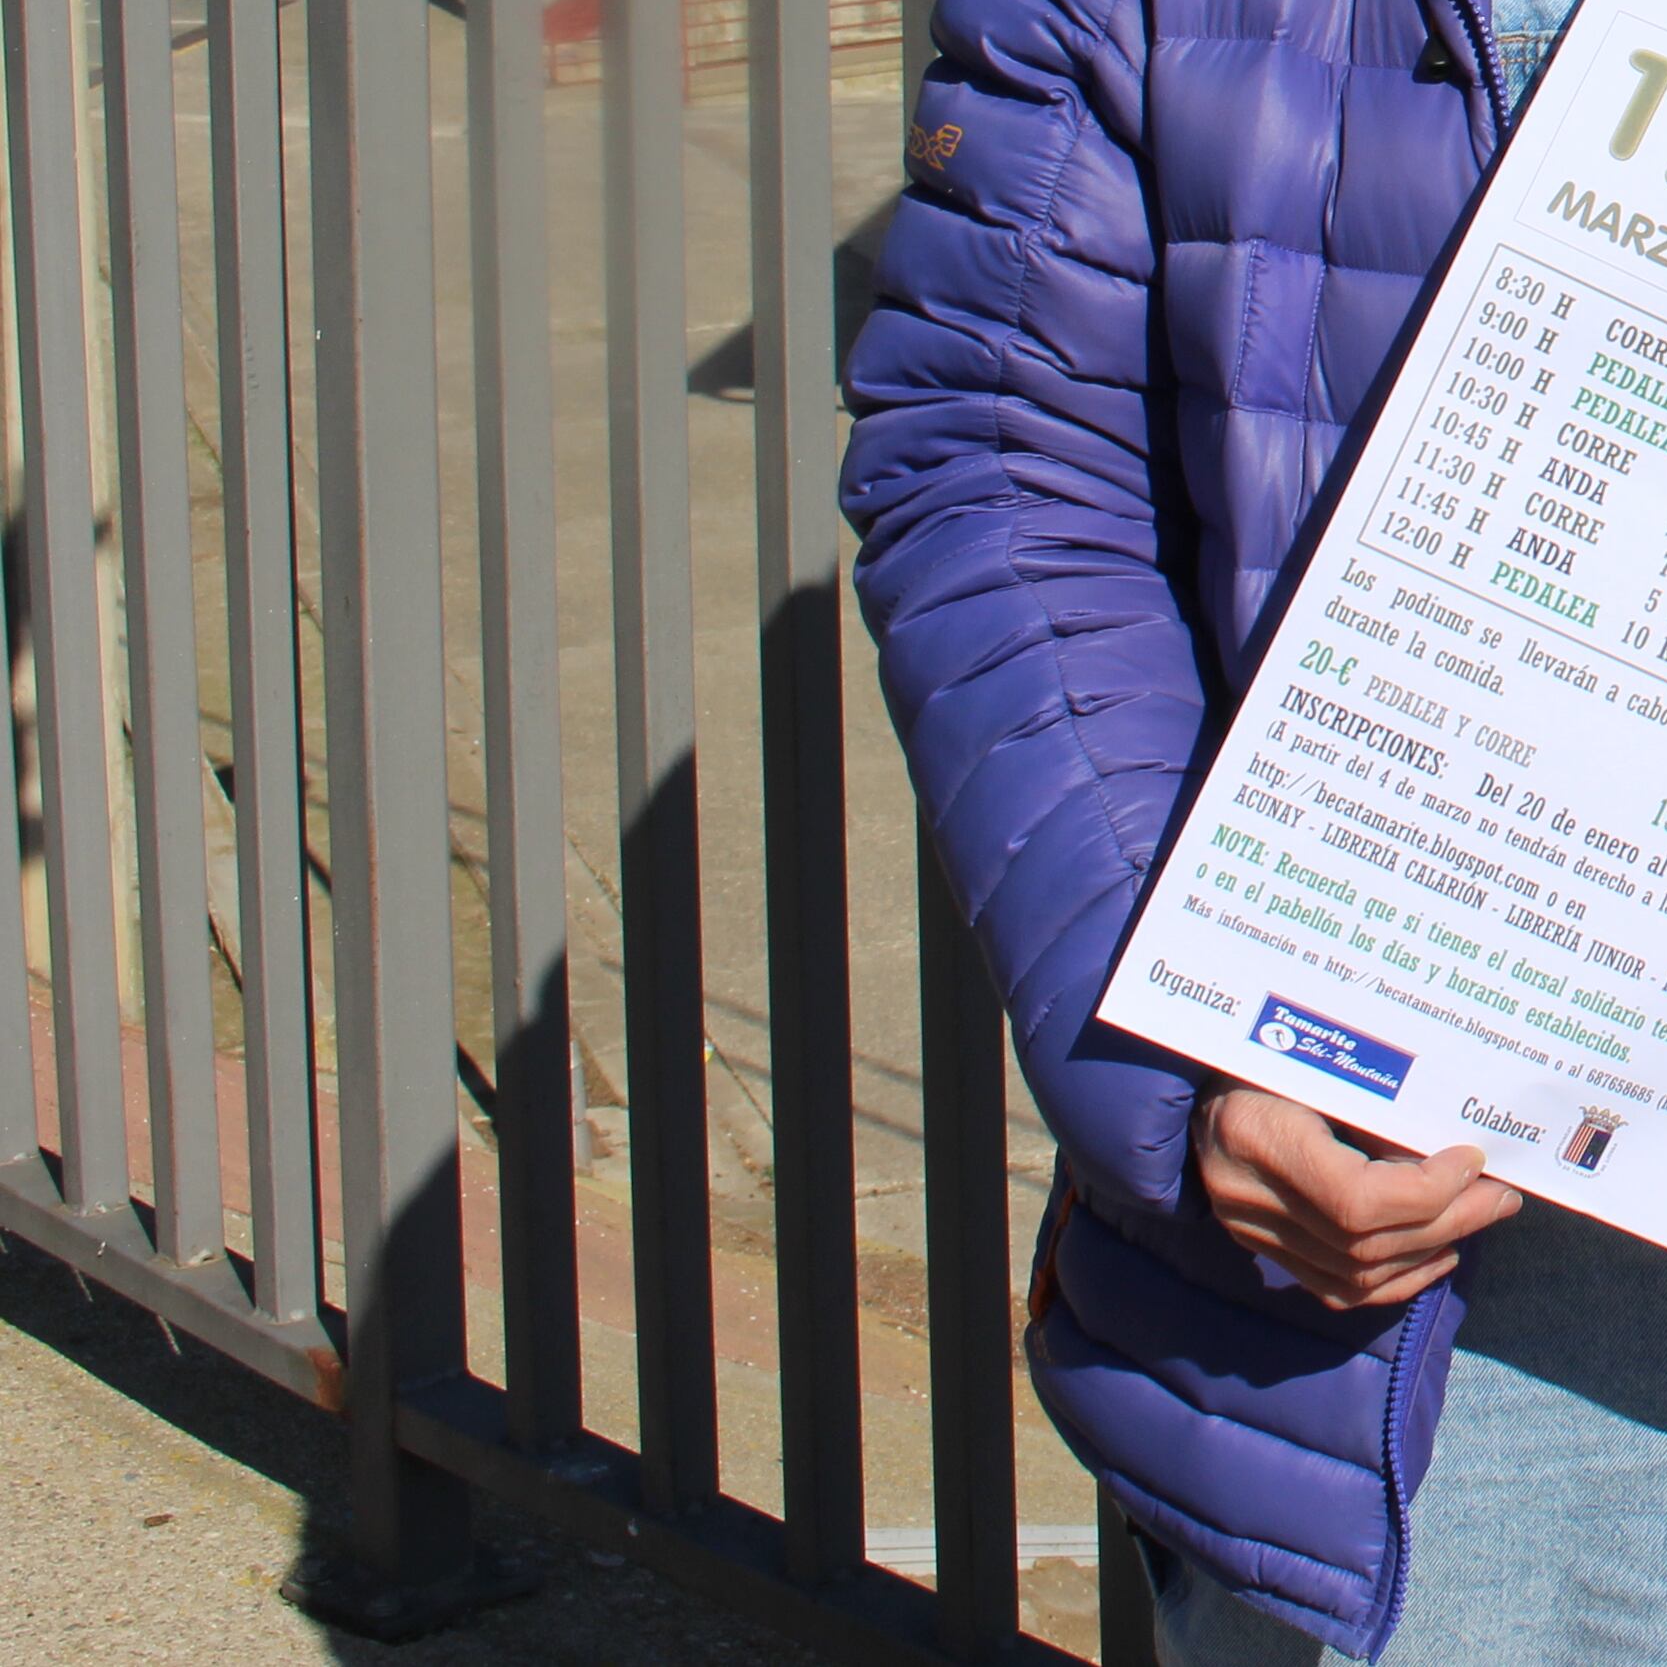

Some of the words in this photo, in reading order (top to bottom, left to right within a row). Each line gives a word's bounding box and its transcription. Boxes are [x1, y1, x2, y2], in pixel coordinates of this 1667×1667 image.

[1477, 301, 1529, 341] 9:00
[1494, 266, 1545, 306] 8:30
[1461, 336, 1525, 381] 10:00
[1428, 405, 1493, 451] 10:45
[1536, 456, 1610, 506] ANDA
[1445, 370, 1508, 416] 10:30
[1556, 421, 1638, 476] CORRE
[1396, 476, 1460, 521] 11:45
[1504, 526, 1578, 577] ANDA
[1412, 440, 1476, 486] 11:30
[1524, 491, 1606, 546] CORRE
[1379, 511, 1443, 556] 12:00
[1488, 559, 1600, 630] PEDALEA
[1323, 594, 1400, 647] durante
[1433, 649, 1504, 697] comida.
[1339, 557, 1377, 592] Los
[1387, 586, 1474, 637] podiums
[1517, 637, 1599, 694] llevarán
[1297, 639, 1359, 687] 20-€
[1362, 674, 1449, 730] PEDALEA
[1473, 724, 1537, 769] CORRE
[1245, 751, 1540, 901] http://becatamarite.blogspot.com
[1278, 683, 1449, 780] INSCRIPCIONES:
[1472, 771, 1514, 808] Del
[1514, 790, 1546, 822] 20
[1583, 827, 1640, 865] enero
[1287, 733, 1342, 766] partir
[1344, 753, 1375, 781] del
[1419, 791, 1472, 826] marzo
[1503, 826, 1567, 869] tendrán
[1572, 855, 1636, 898] derecho
[1209, 823, 1270, 867] NOTA:
[1272, 851, 1357, 907] Recuerda
[1362, 897, 1397, 924] que
[1426, 921, 1482, 961] tienes
[1509, 957, 1569, 999] dorsal
[1568, 988, 1646, 1031] solidario
[1231, 783, 1306, 829] ACUNAY
[1319, 821, 1401, 873] LIBRERÍA
[1403, 858, 1490, 911] CALARIÓN
[1503, 902, 1583, 954] LIBRERÍA
[1582, 938, 1646, 981] JUNIOR
[1148, 958, 1241, 1017] Organiza:
[1181, 893, 1213, 919] Más
[1216, 908, 1297, 956] información
[1323, 955, 1549, 1066] http://becatamarite.blogspot.com
[1585, 1068, 1655, 1104] 687658685
[1263, 893, 1343, 939] pabellón
[1346, 923, 1377, 954] los
[1380, 939, 1421, 973] días
[1444, 966, 1520, 1016] horarios
[1524, 1006, 1631, 1064] establecidos.
[1274, 1005, 1357, 1051] Tamarite
[1296, 1037, 1399, 1089] Ski-Montaña
[1460, 1096, 1547, 1145] Colabora:
